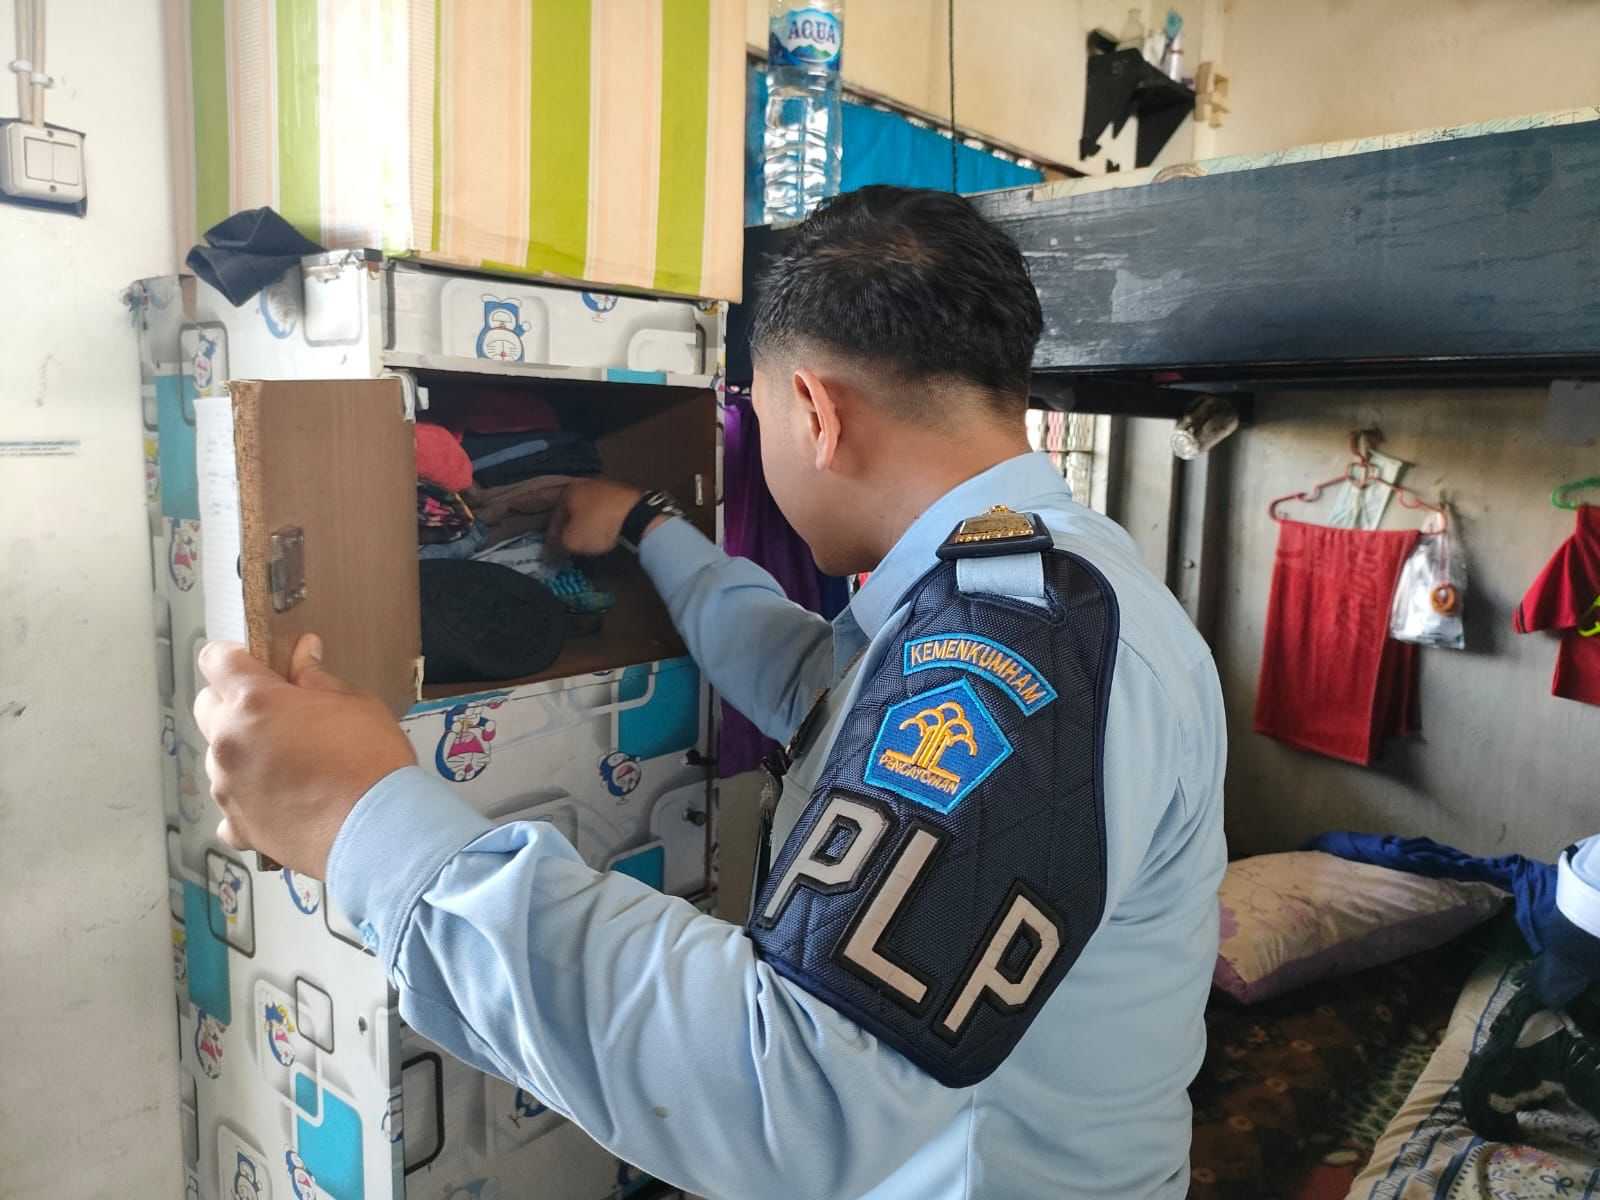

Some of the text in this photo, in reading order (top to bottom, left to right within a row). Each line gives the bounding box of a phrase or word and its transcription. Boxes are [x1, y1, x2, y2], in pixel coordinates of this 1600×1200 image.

[788, 19, 836, 44] AQUA
[911, 639, 1047, 705] KEMENKUMHAM
[879, 754, 960, 796] PENGAYOMAN
[761, 797, 1061, 1034] PLP
